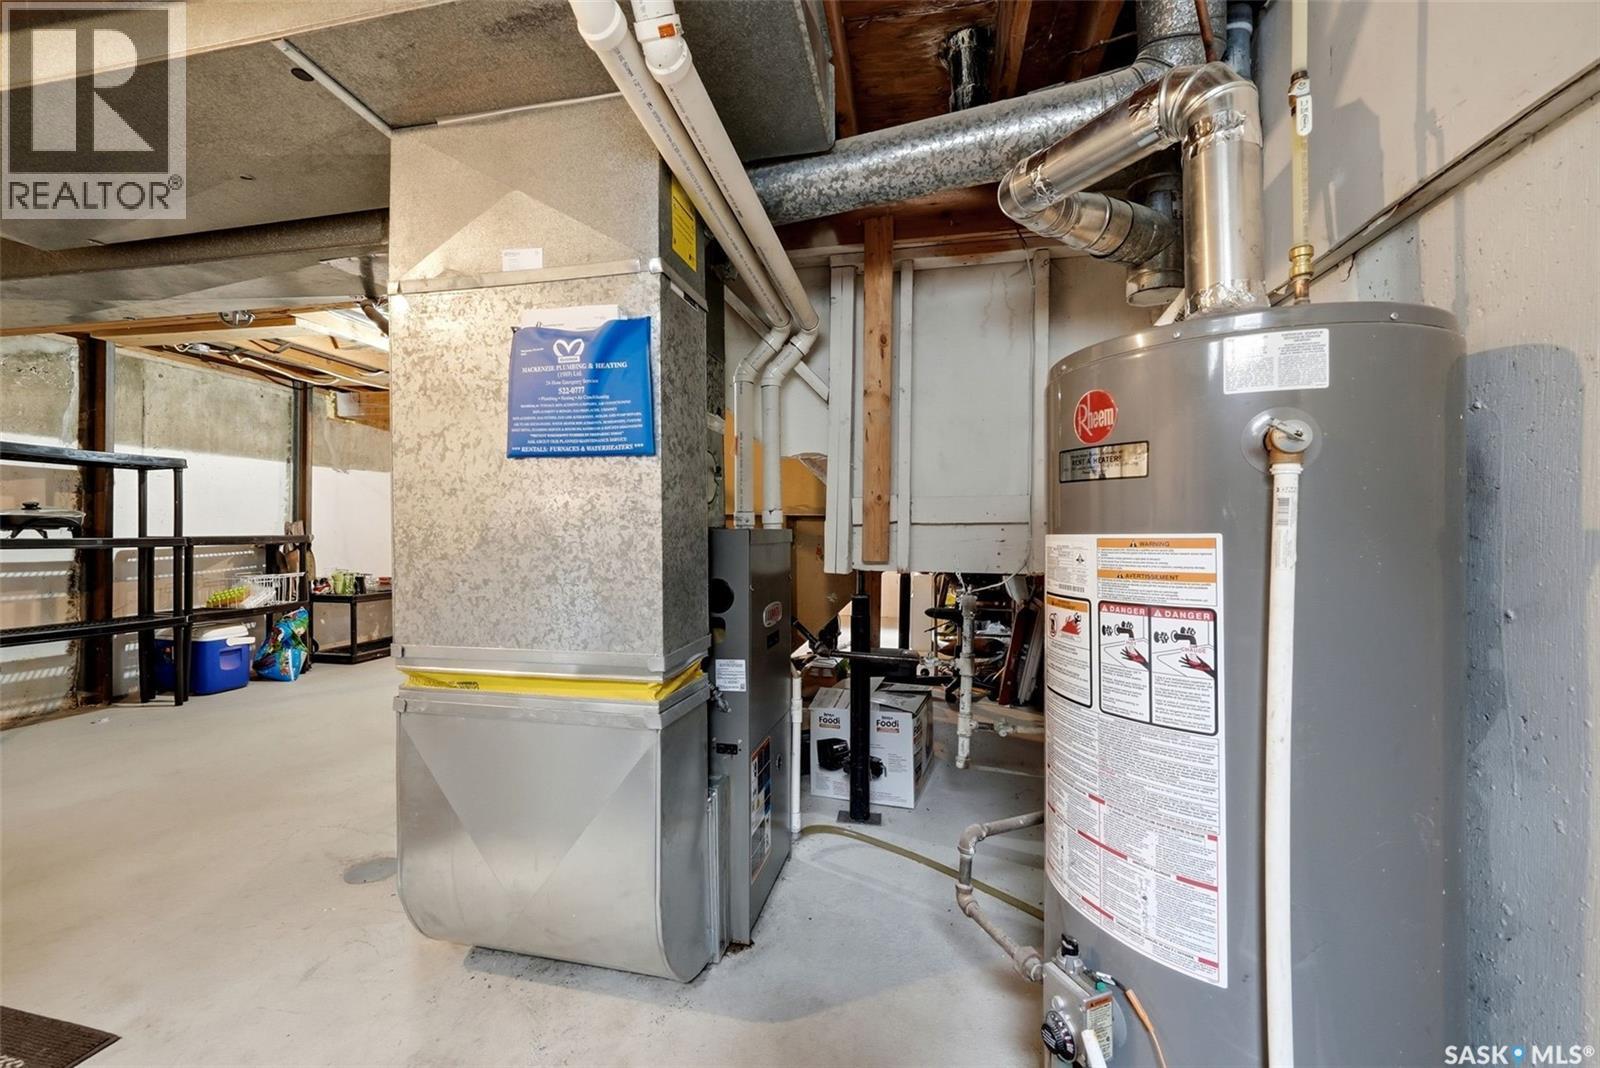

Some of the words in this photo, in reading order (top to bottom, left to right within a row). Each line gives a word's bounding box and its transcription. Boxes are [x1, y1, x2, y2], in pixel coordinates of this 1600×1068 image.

[556, 363, 586, 371] PLUMBING
[595, 361, 628, 369] HEATING
[1077, 392, 1115, 437] Rheem
[1125, 573, 1179, 581] AVERTISSEMENT
[1109, 605, 1146, 616] DANGER
[1165, 610, 1211, 620] DANGER
[818, 715, 841, 724] Foodi
[876, 719, 900, 728] Foodi
